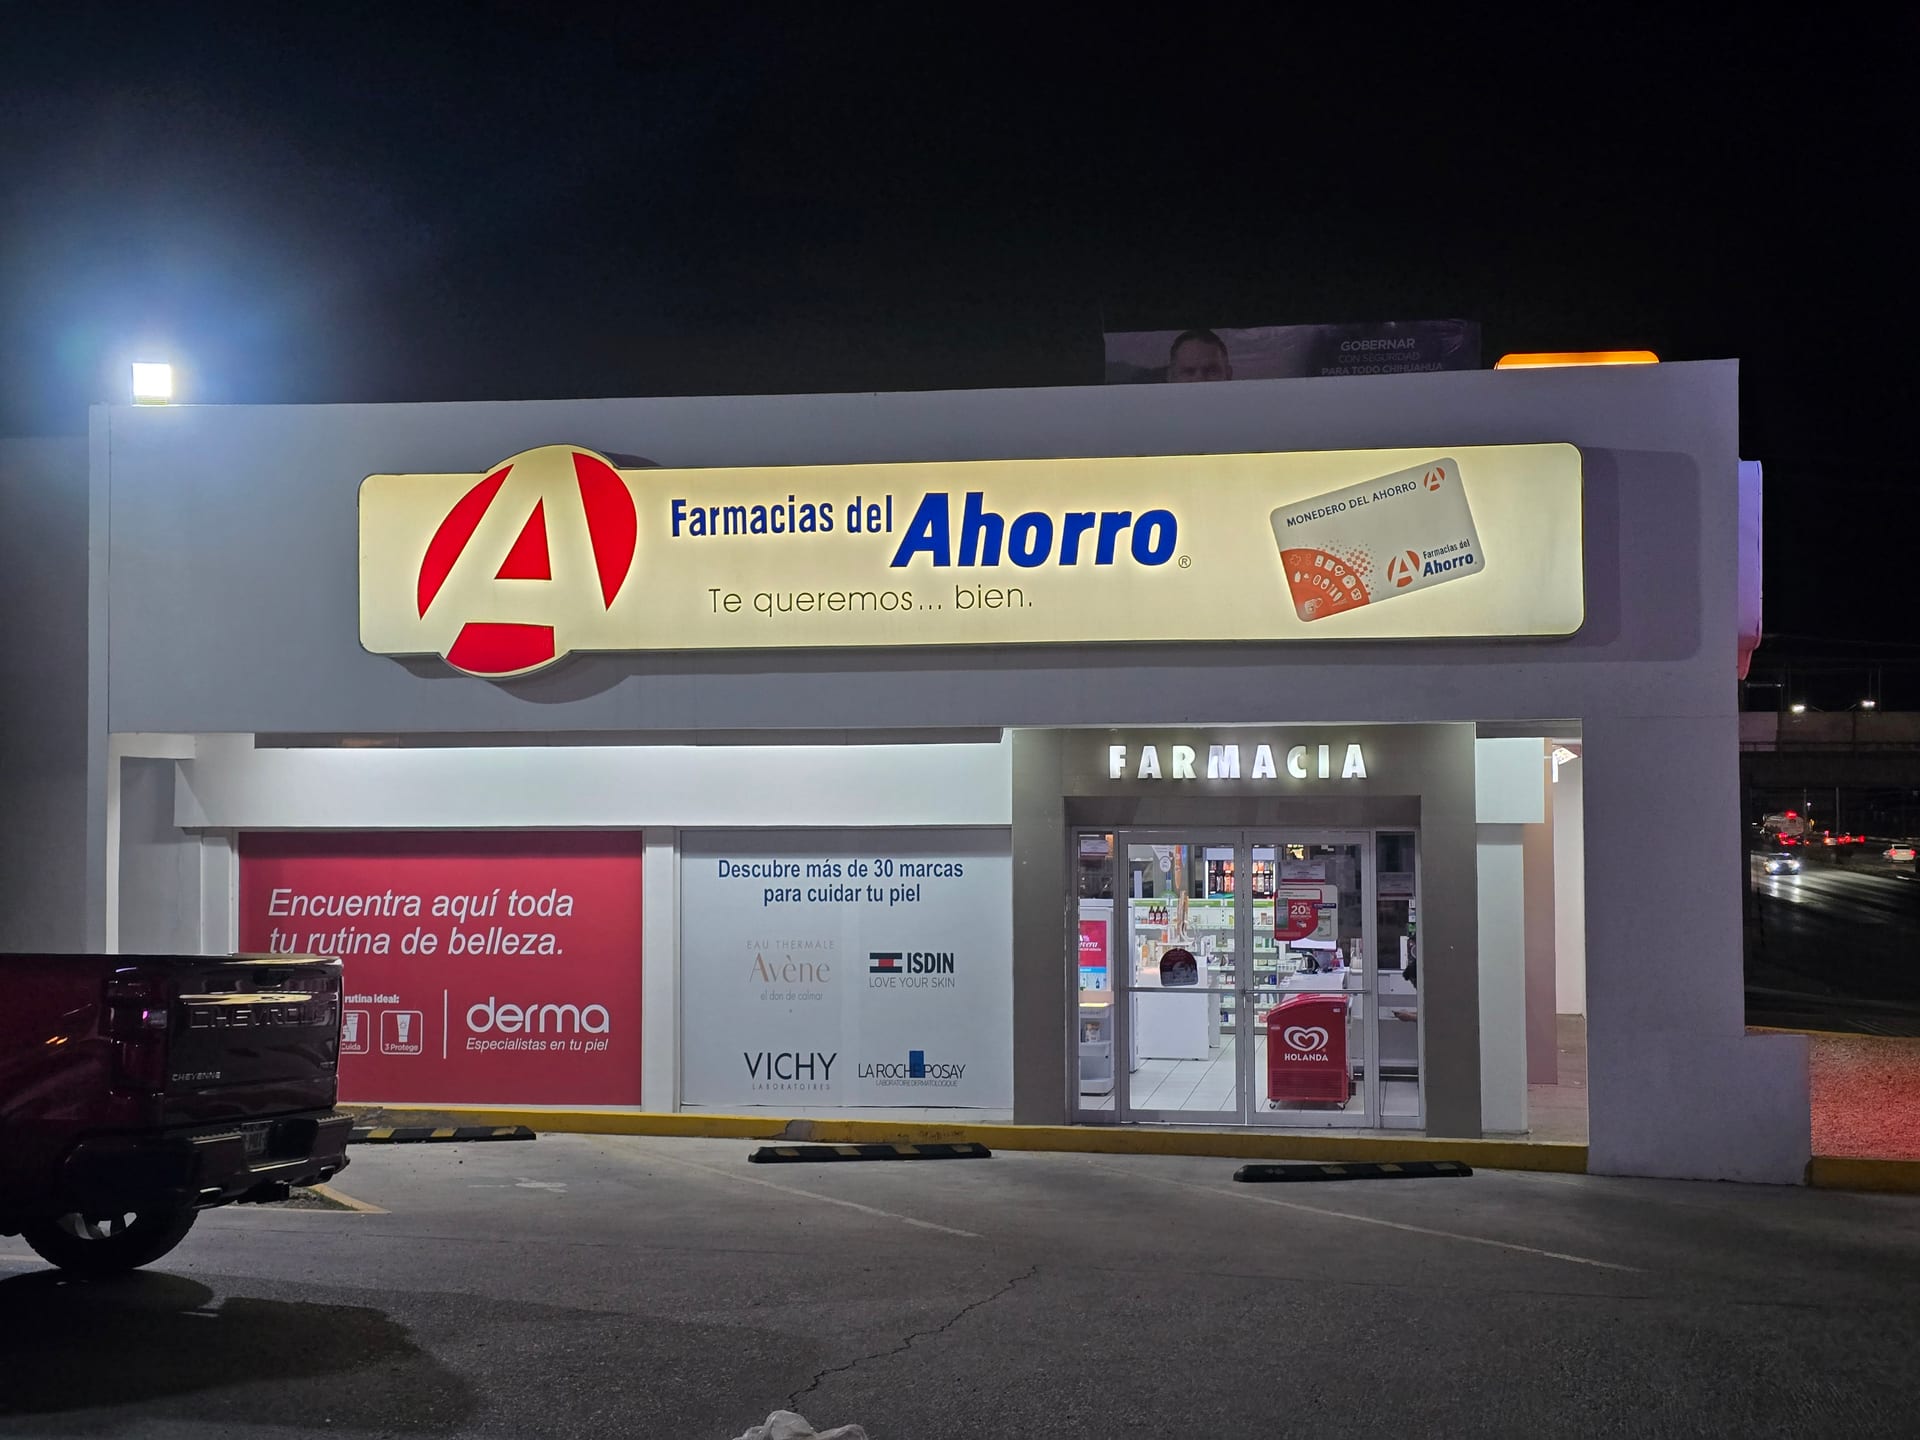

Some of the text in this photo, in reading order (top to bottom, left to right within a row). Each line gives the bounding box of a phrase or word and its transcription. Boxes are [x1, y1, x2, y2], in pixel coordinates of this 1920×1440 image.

[1340, 338, 1416, 352] GOBERNAR
[1321, 362, 1442, 376] PARA TODO CHIHUAHUA
[1286, 480, 1417, 528] MONEDERO DEL AHORRO
[671, 491, 1178, 568] Farmacias del Ahorro
[1423, 538, 1471, 560] Farmacias del
[1422, 552, 1475, 578] Ahorro
[708, 583, 1033, 618] Te queremos... bien.
[1108, 744, 1368, 780] FARMACIA
[718, 859, 964, 878] Descubre más de 30 marcas
[268, 887, 574, 923] Encuentra aquí toda
[763, 884, 921, 907] para cuidar tu piel
[270, 927, 563, 955] tu rutina de belleza.
[747, 940, 835, 949] EAU THERMALE
[750, 952, 832, 983] Avène
[907, 952, 954, 974] ISDIN
[869, 976, 956, 989] LOVE YOUR SKIN
[344, 993, 400, 1004] rutina ideal:
[760, 988, 823, 1001] el don de calmar
[466, 996, 610, 1034] derma
[384, 1042, 419, 1053] 3 Protege
[466, 1037, 609, 1053] Especialistas en tu piel
[743, 1052, 838, 1081] VICHY
[1284, 1053, 1329, 1062] HOLANDA
[172, 1071, 222, 1082] CHEYENNE
[858, 1063, 875, 1079] LA
[752, 1082, 831, 1091] LABORATOIRES
